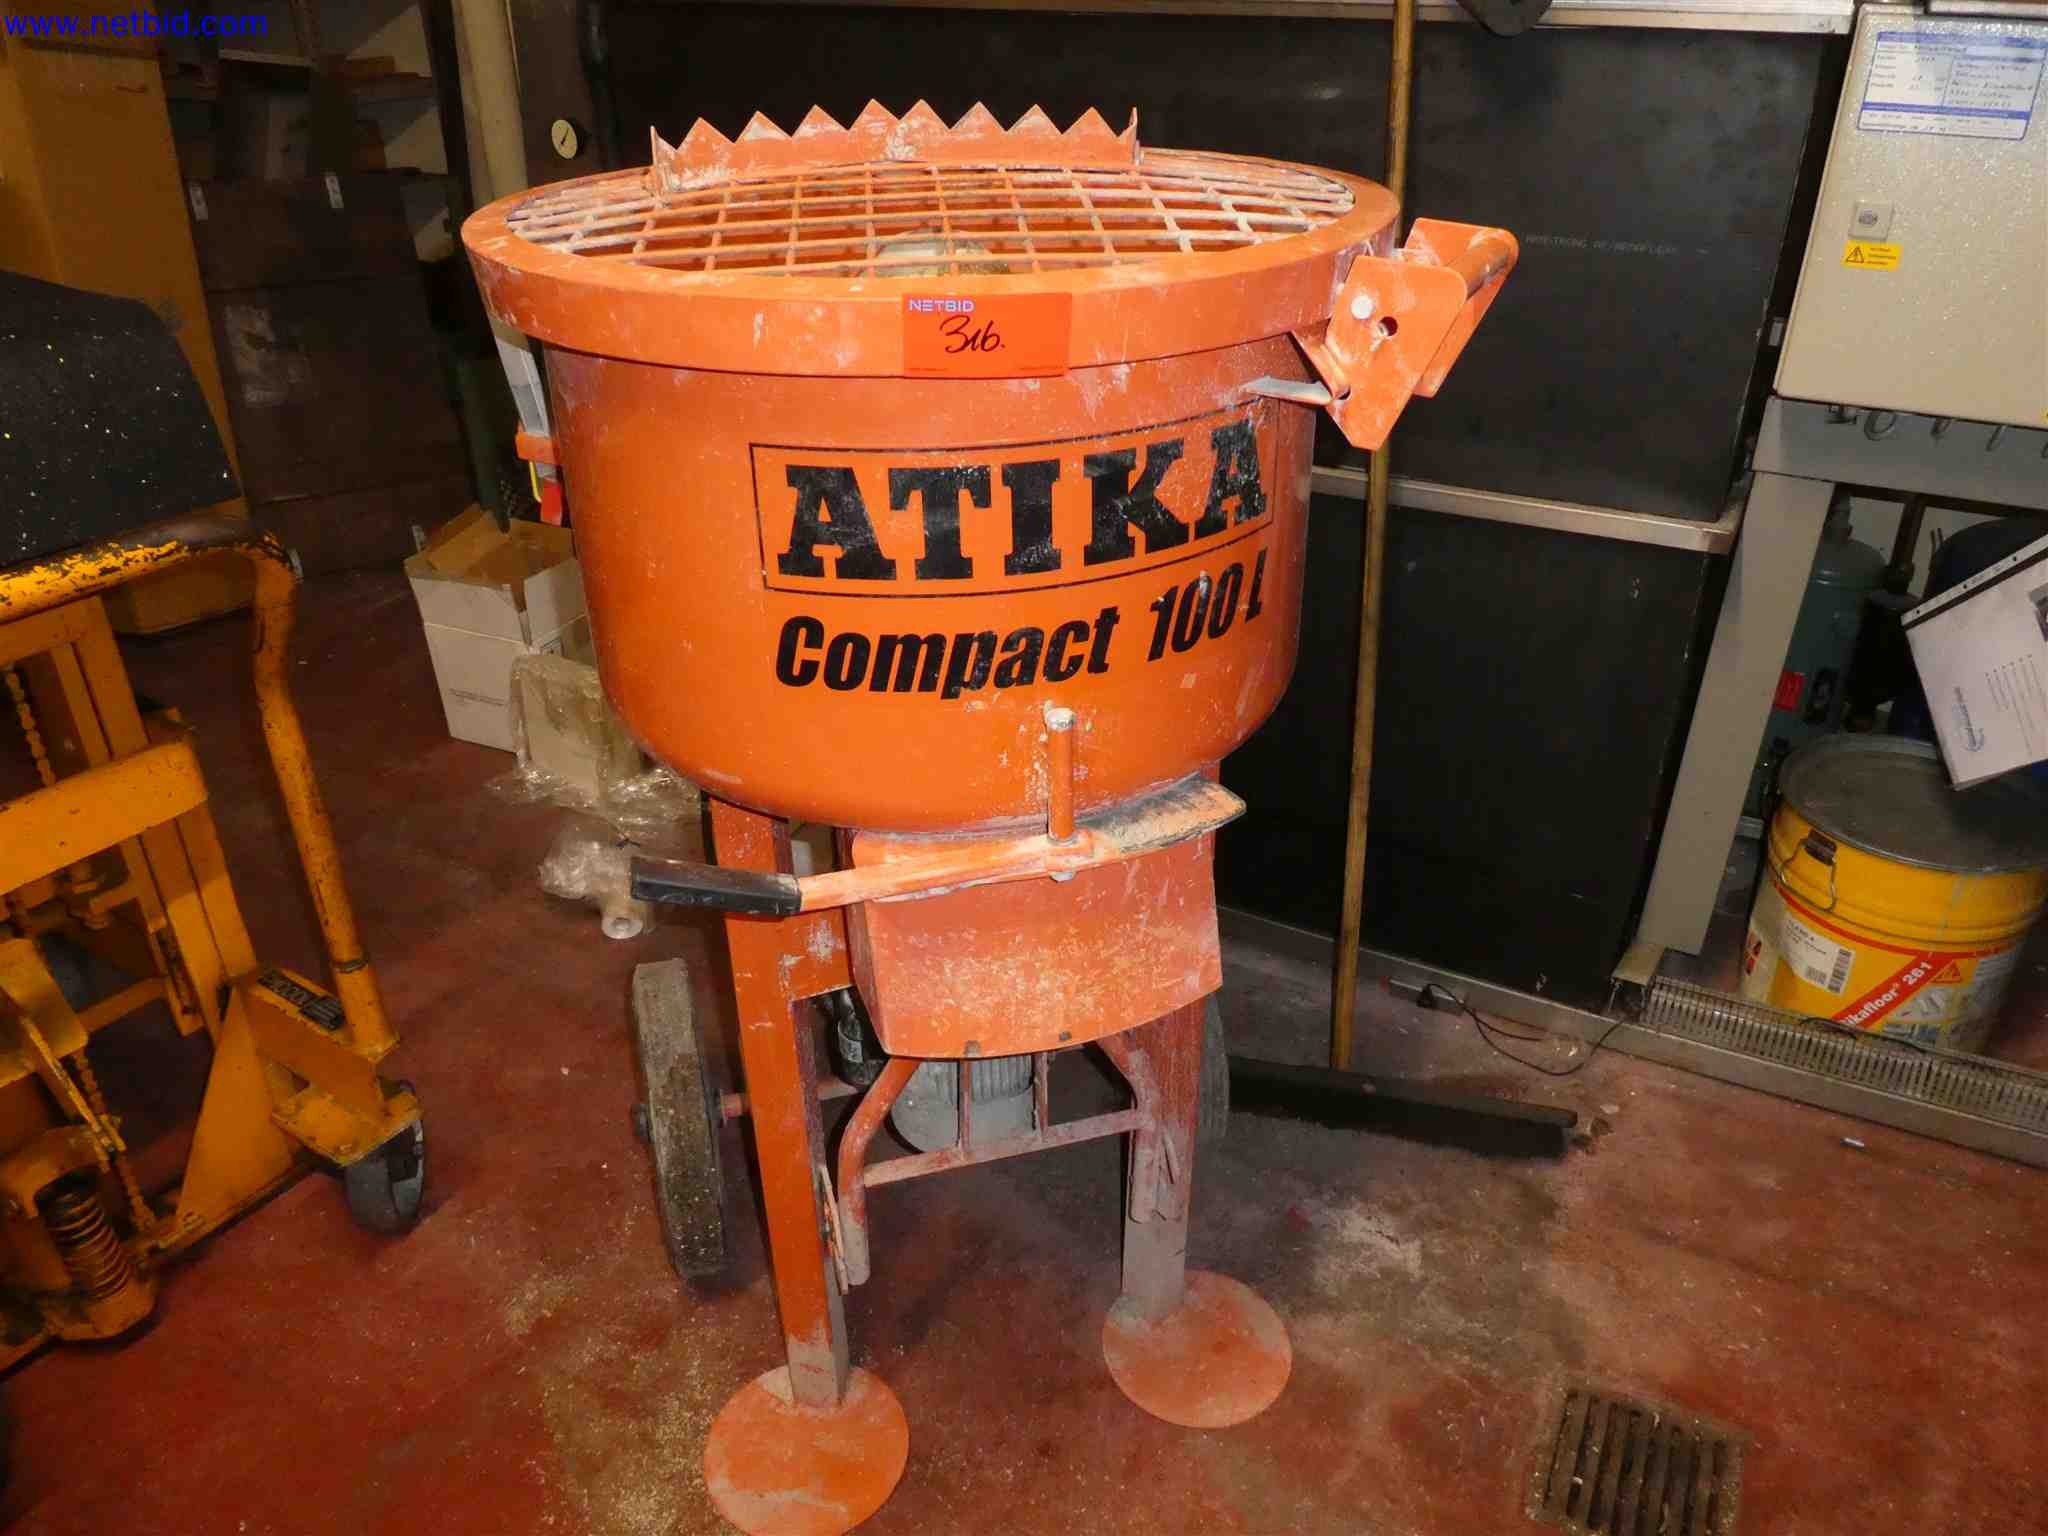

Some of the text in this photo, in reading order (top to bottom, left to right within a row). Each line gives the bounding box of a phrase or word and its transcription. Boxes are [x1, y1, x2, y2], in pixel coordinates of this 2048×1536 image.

[908, 299, 976, 313] NETBID
[777, 418, 1268, 580] ATIKA
[776, 606, 1121, 700] Compact
[1147, 561, 1244, 662] 100
